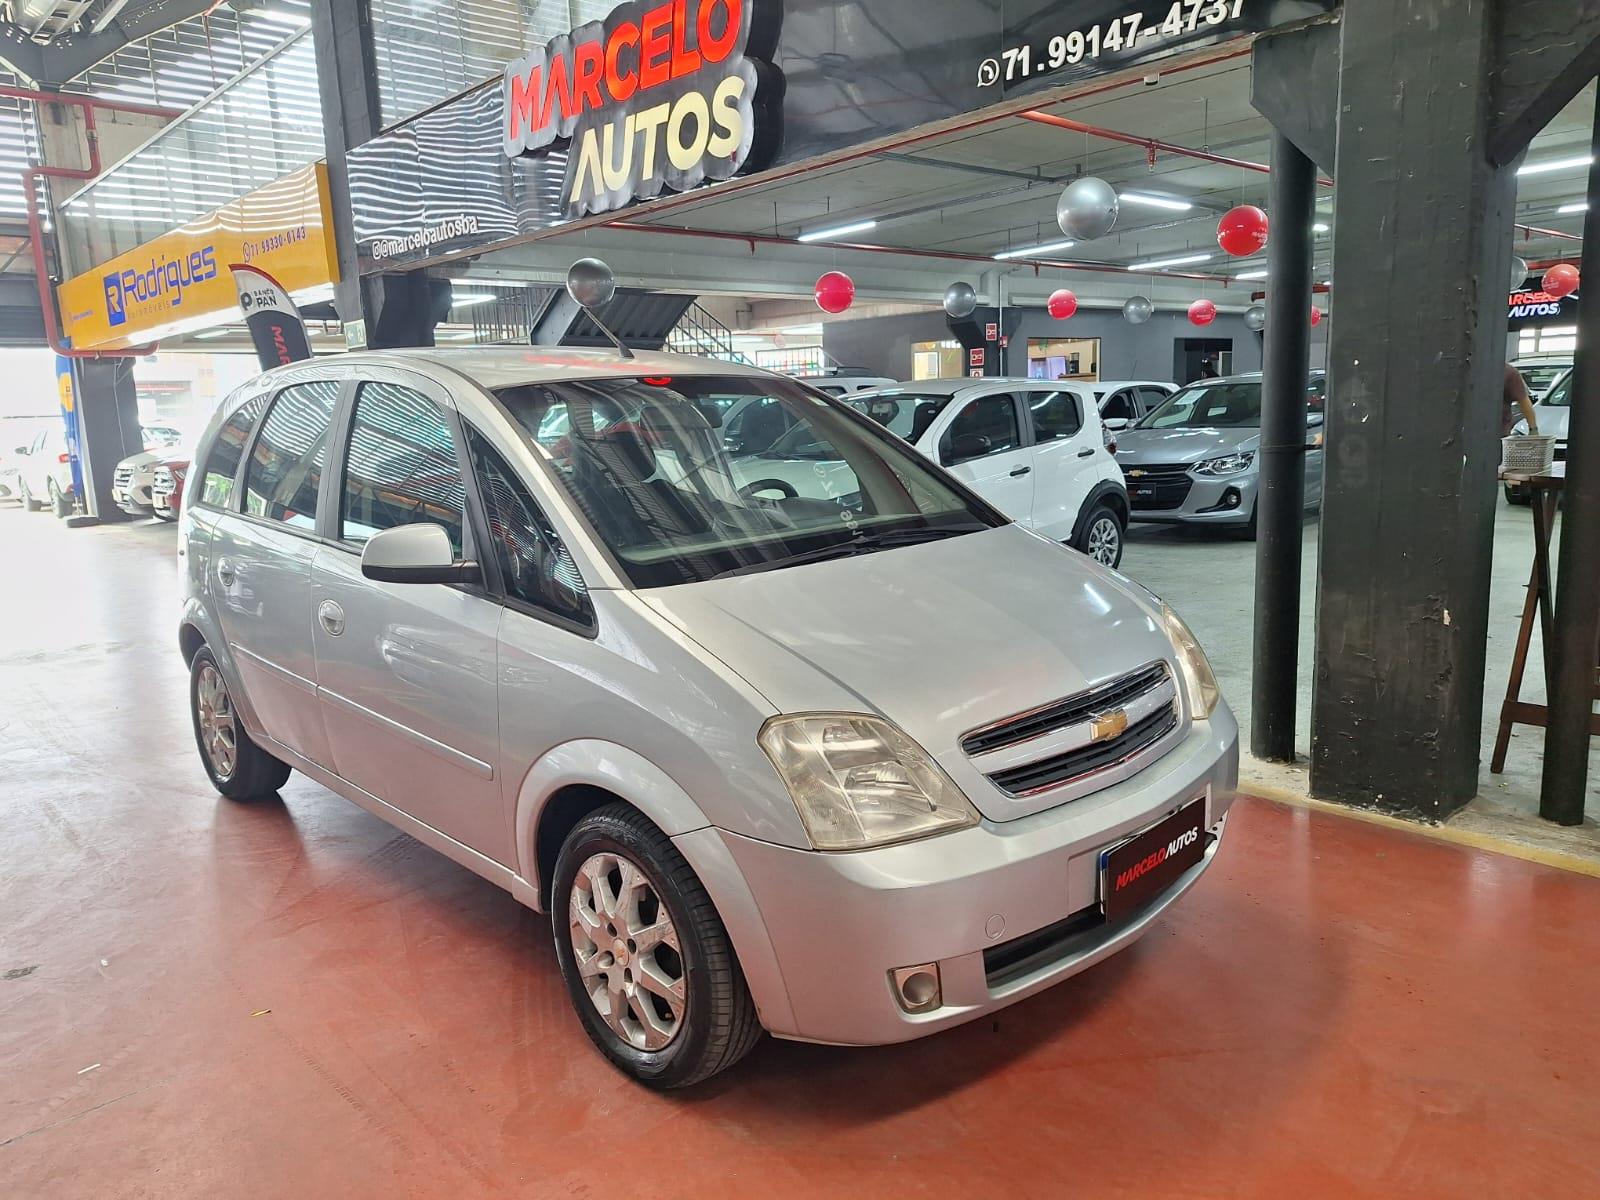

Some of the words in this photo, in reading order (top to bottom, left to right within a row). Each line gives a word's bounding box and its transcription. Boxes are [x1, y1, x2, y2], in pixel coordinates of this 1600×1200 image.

[510, 0, 742, 141] MARCELO
[570, 75, 746, 203] AUTOS
[122, 246, 217, 307] Rodrigues
[256, 296, 277, 308] PAN
[1508, 303, 1559, 318] AUTOS
